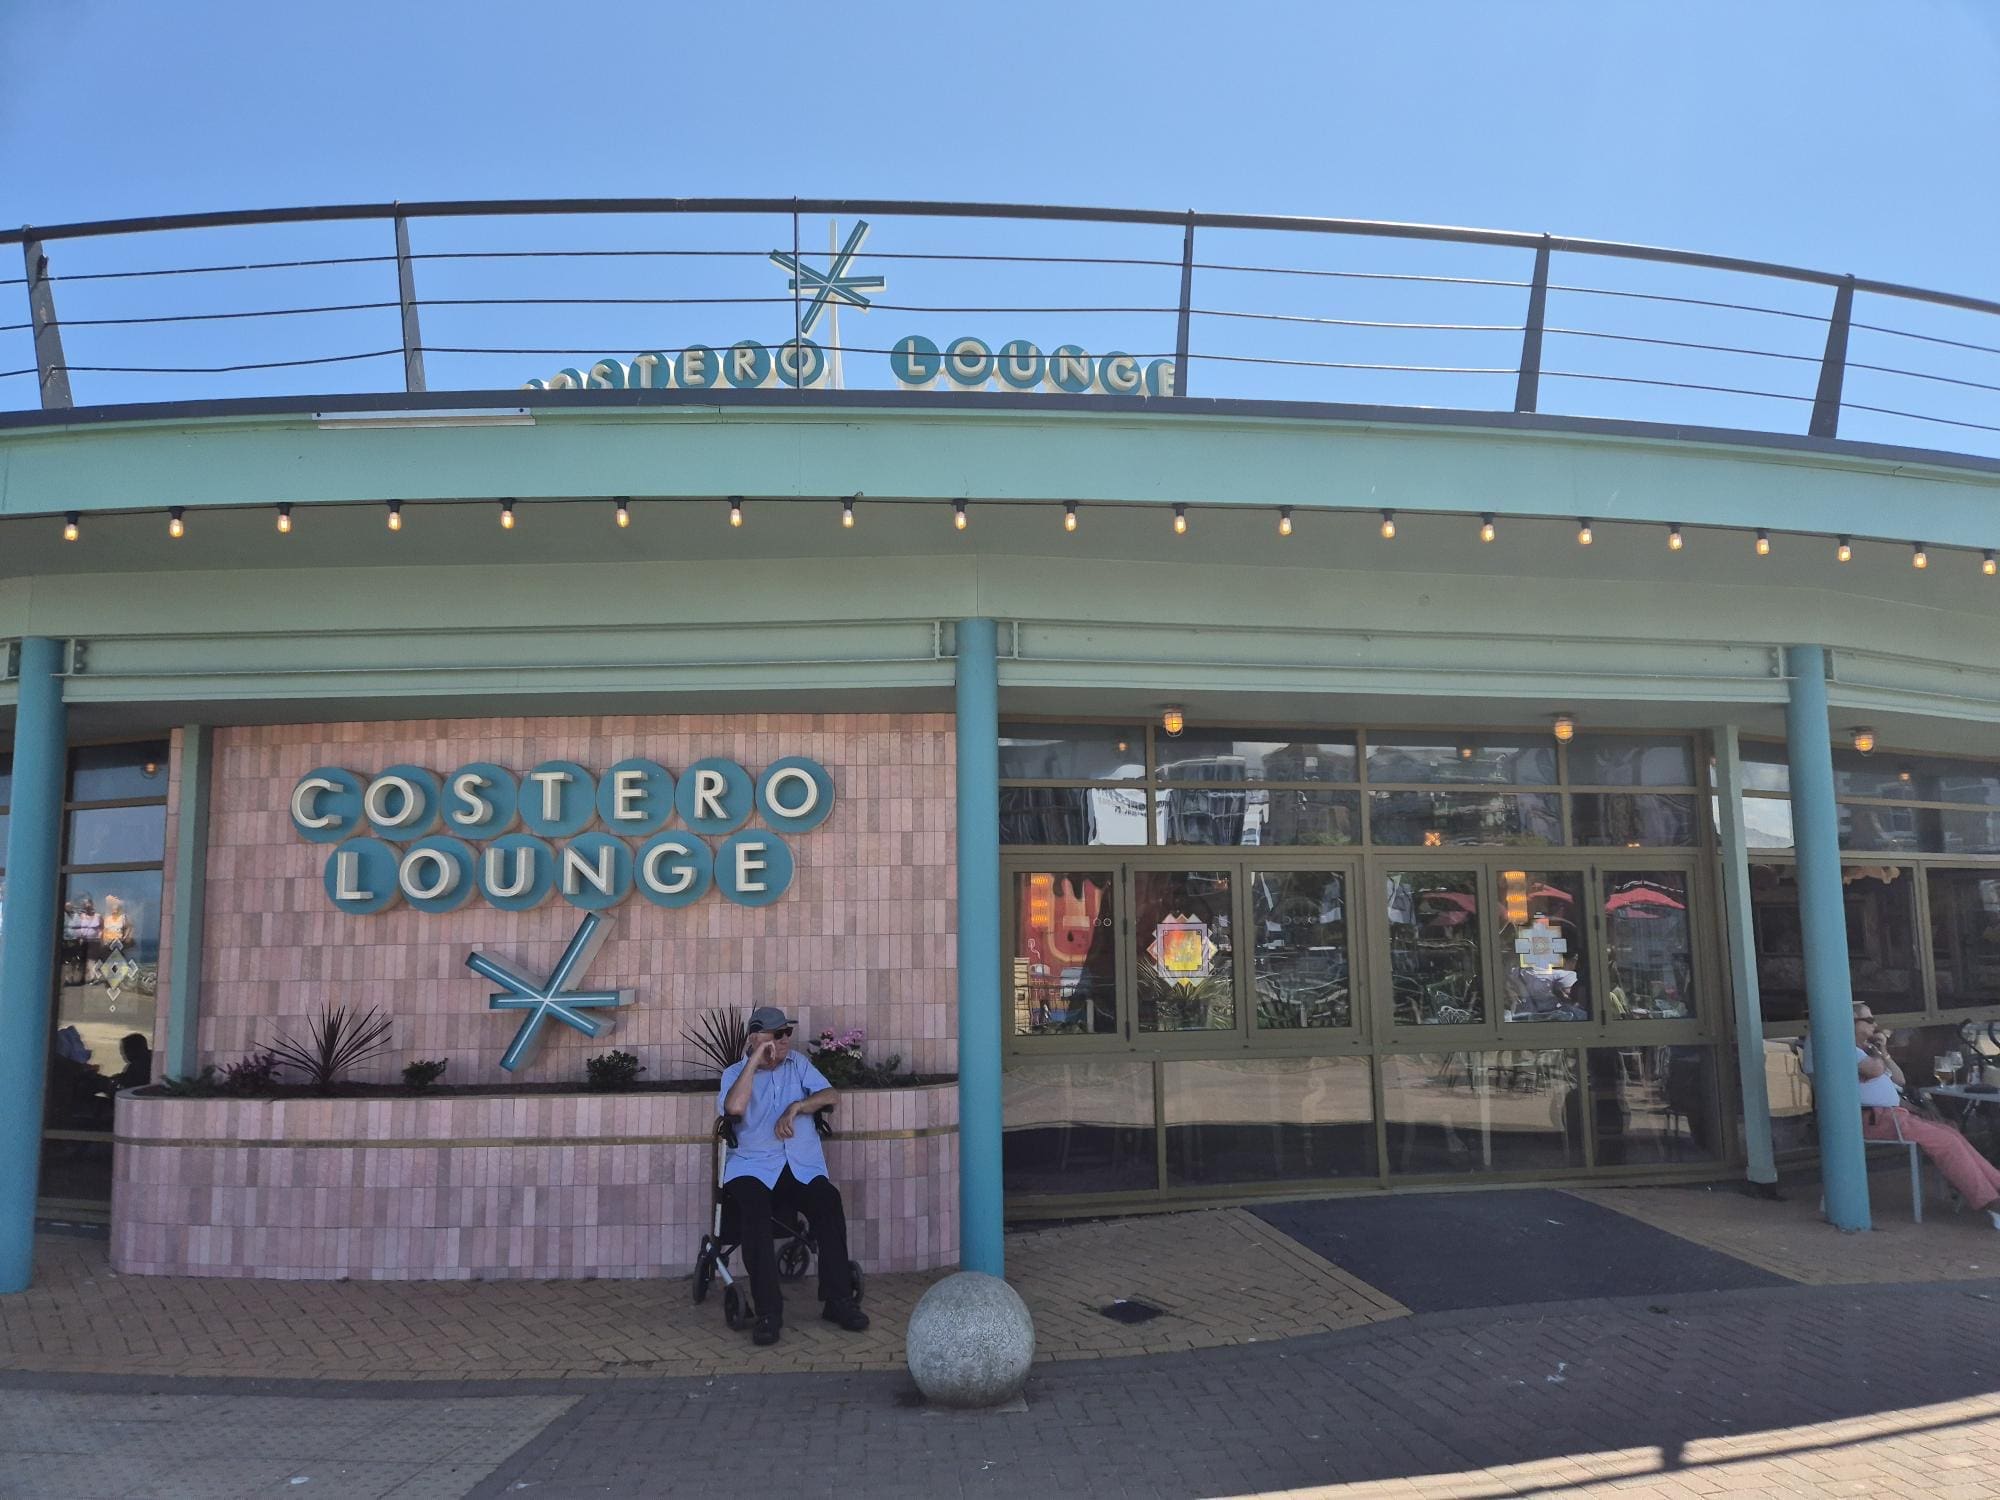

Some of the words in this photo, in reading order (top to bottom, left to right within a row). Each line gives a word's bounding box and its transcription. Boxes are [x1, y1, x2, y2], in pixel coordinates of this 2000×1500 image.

[523, 340, 816, 390] STERO
[906, 339, 1176, 397] LOUNGE
[291, 767, 819, 829] COSTERO
[335, 842, 768, 901] LOUNGE
